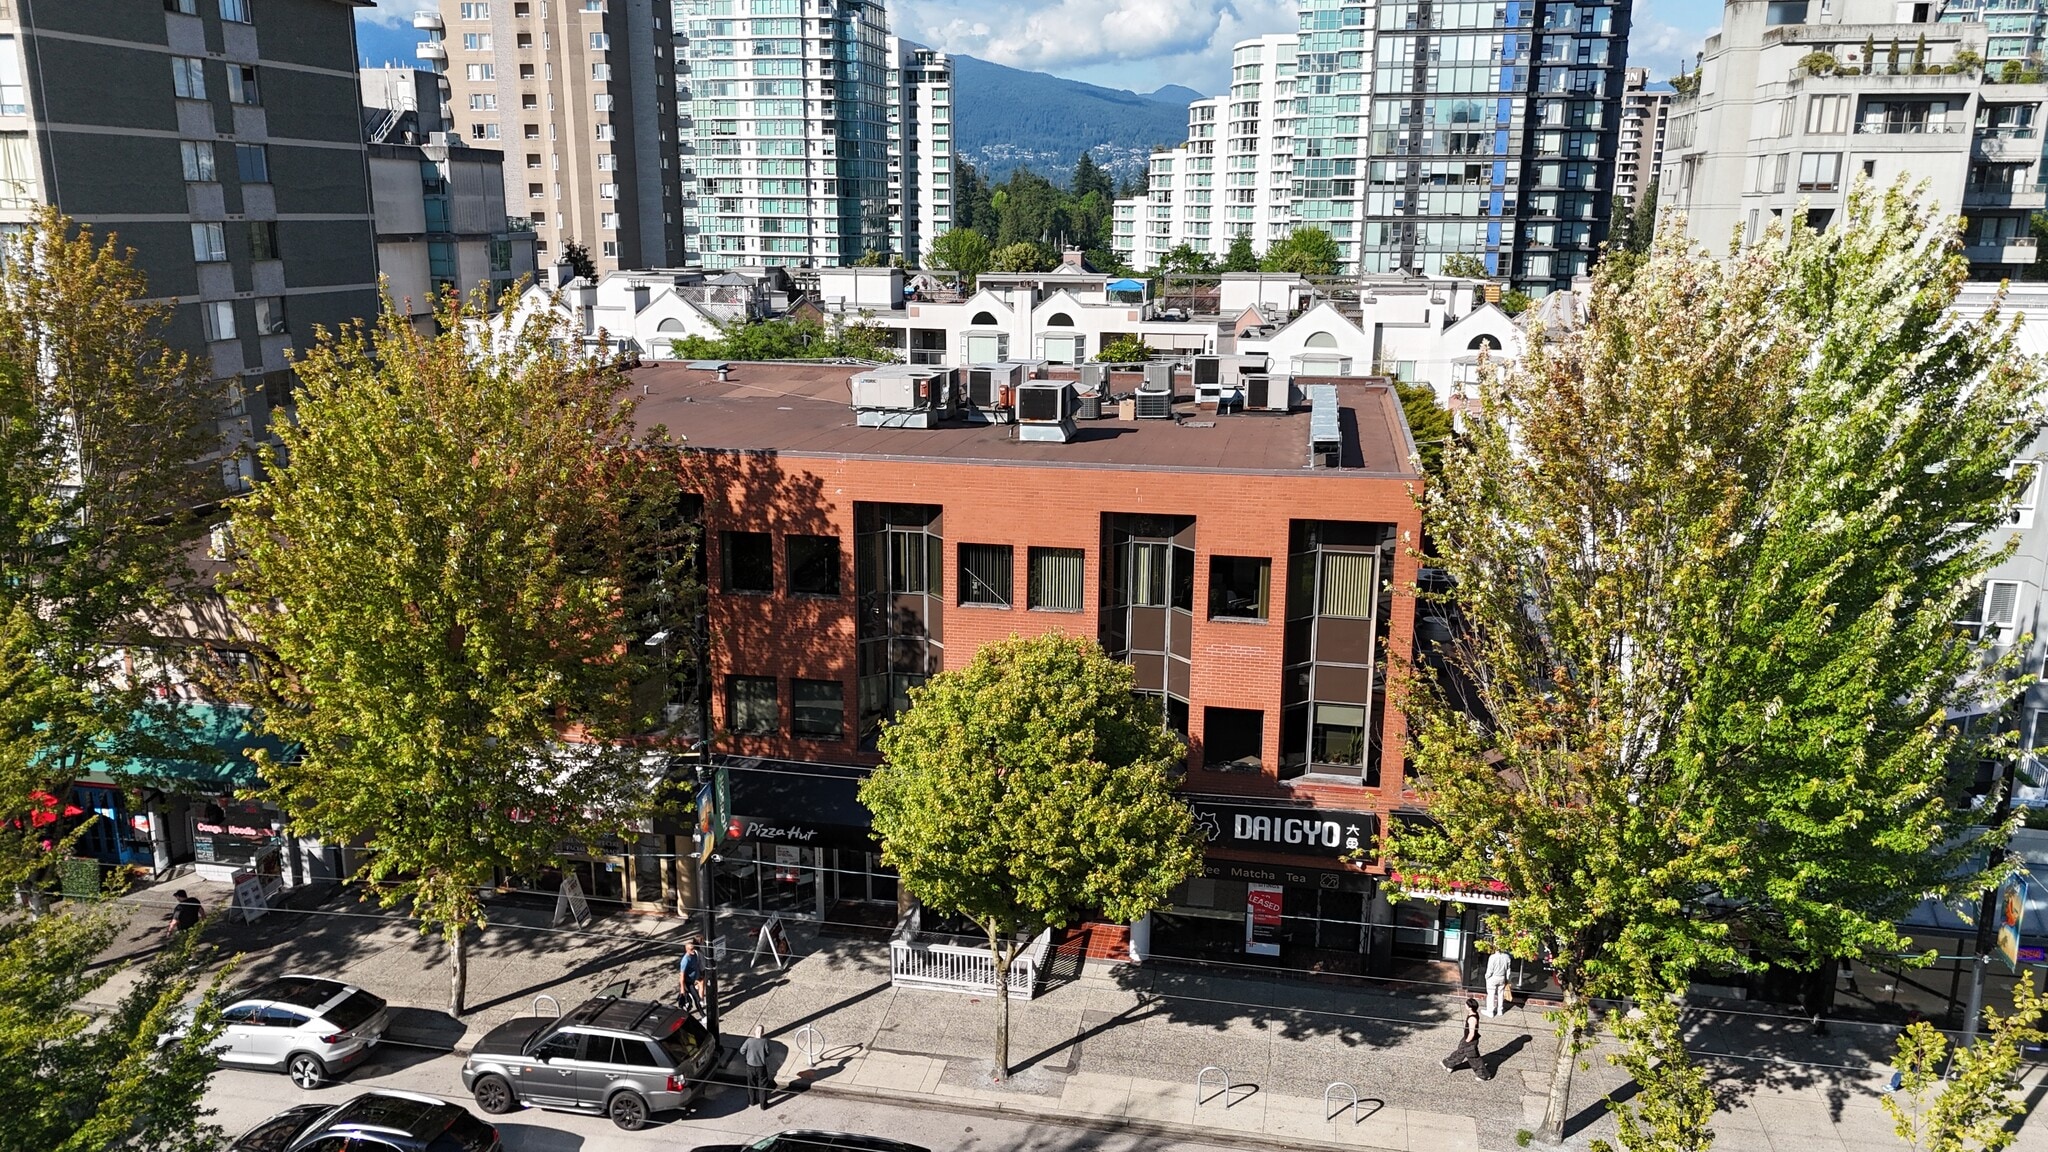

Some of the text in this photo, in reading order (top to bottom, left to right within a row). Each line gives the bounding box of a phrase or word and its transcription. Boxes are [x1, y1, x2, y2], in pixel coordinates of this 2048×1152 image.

[745, 822, 818, 840] Pizza Hut
[1234, 814, 1341, 848] DAIGYO
[1231, 867, 1275, 880] Matcha
[1286, 872, 1306, 883] Tea
[1248, 895, 1280, 912] LEASED
